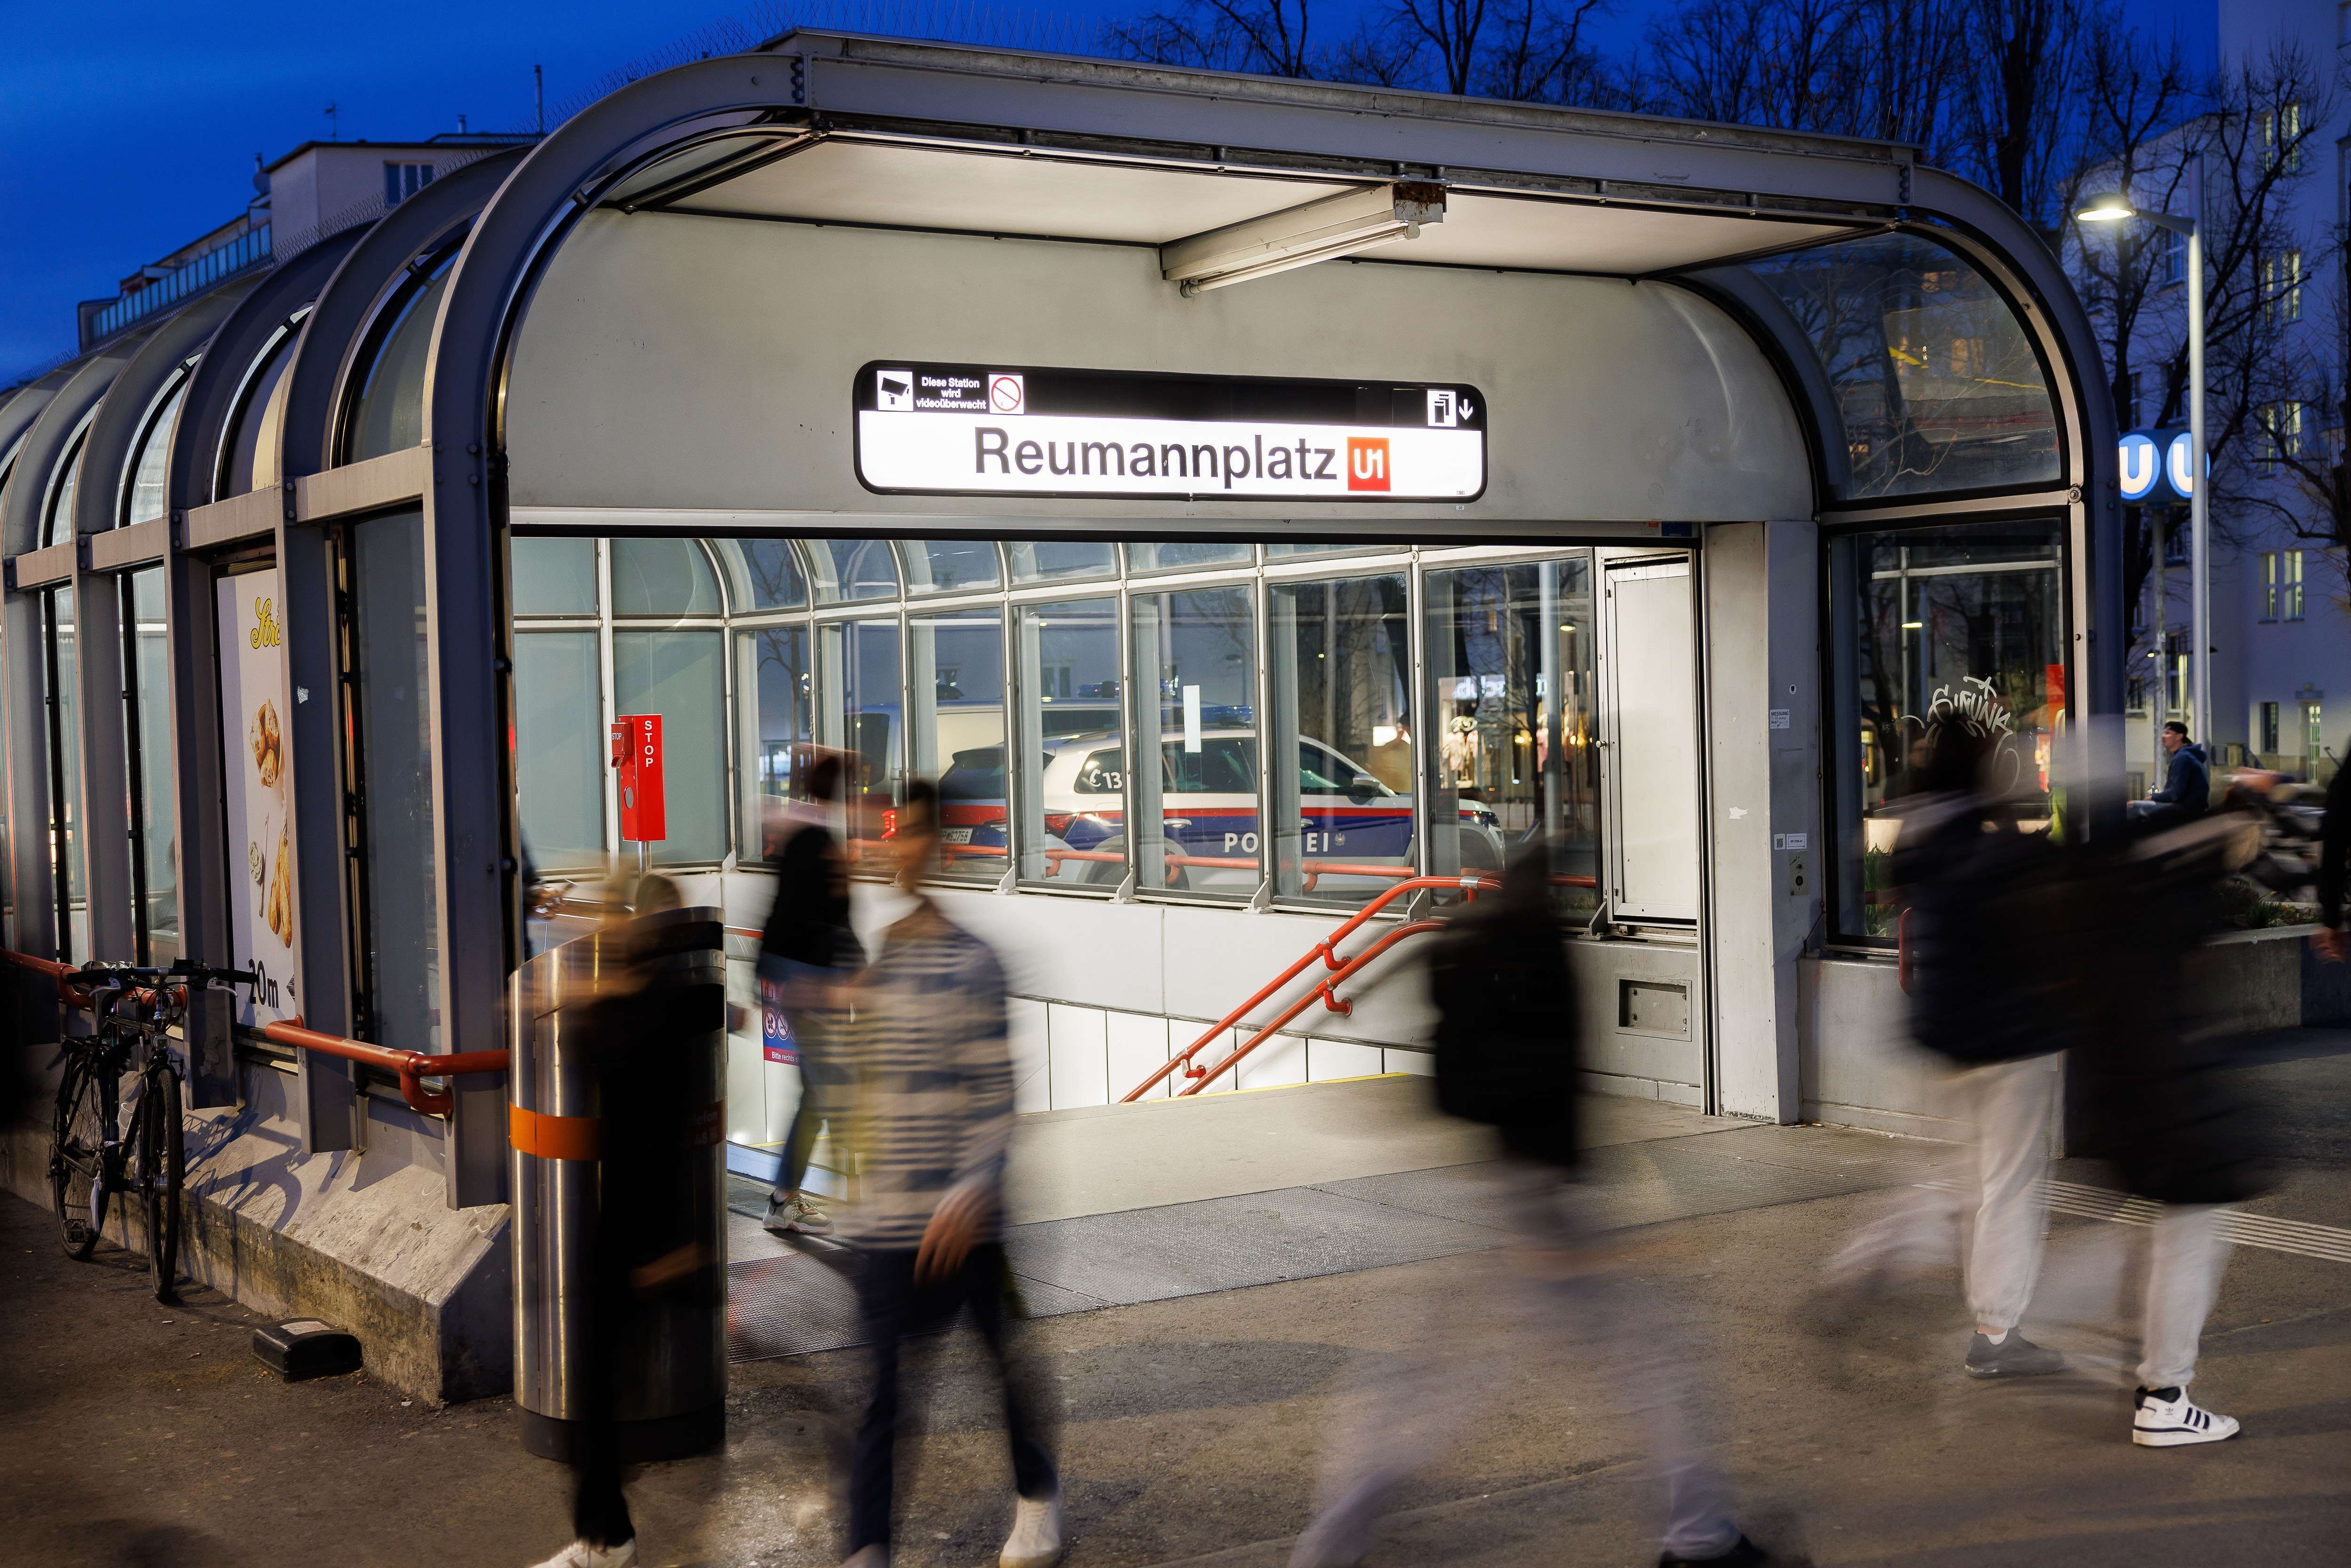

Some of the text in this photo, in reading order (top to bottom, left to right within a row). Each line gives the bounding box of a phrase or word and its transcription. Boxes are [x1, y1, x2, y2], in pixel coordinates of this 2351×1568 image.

[922, 377, 979, 388] Diese Station
[941, 389, 961, 398] wird
[916, 398, 986, 410] videoüberwacht
[975, 427, 1383, 489] Reumannplatz U1
[2119, 443, 2153, 494] U
[645, 720, 654, 768] STOP
[1102, 772, 1123, 789] 13
[1224, 832, 1329, 853] POEI
[772, 1051, 781, 1060] Bitte
